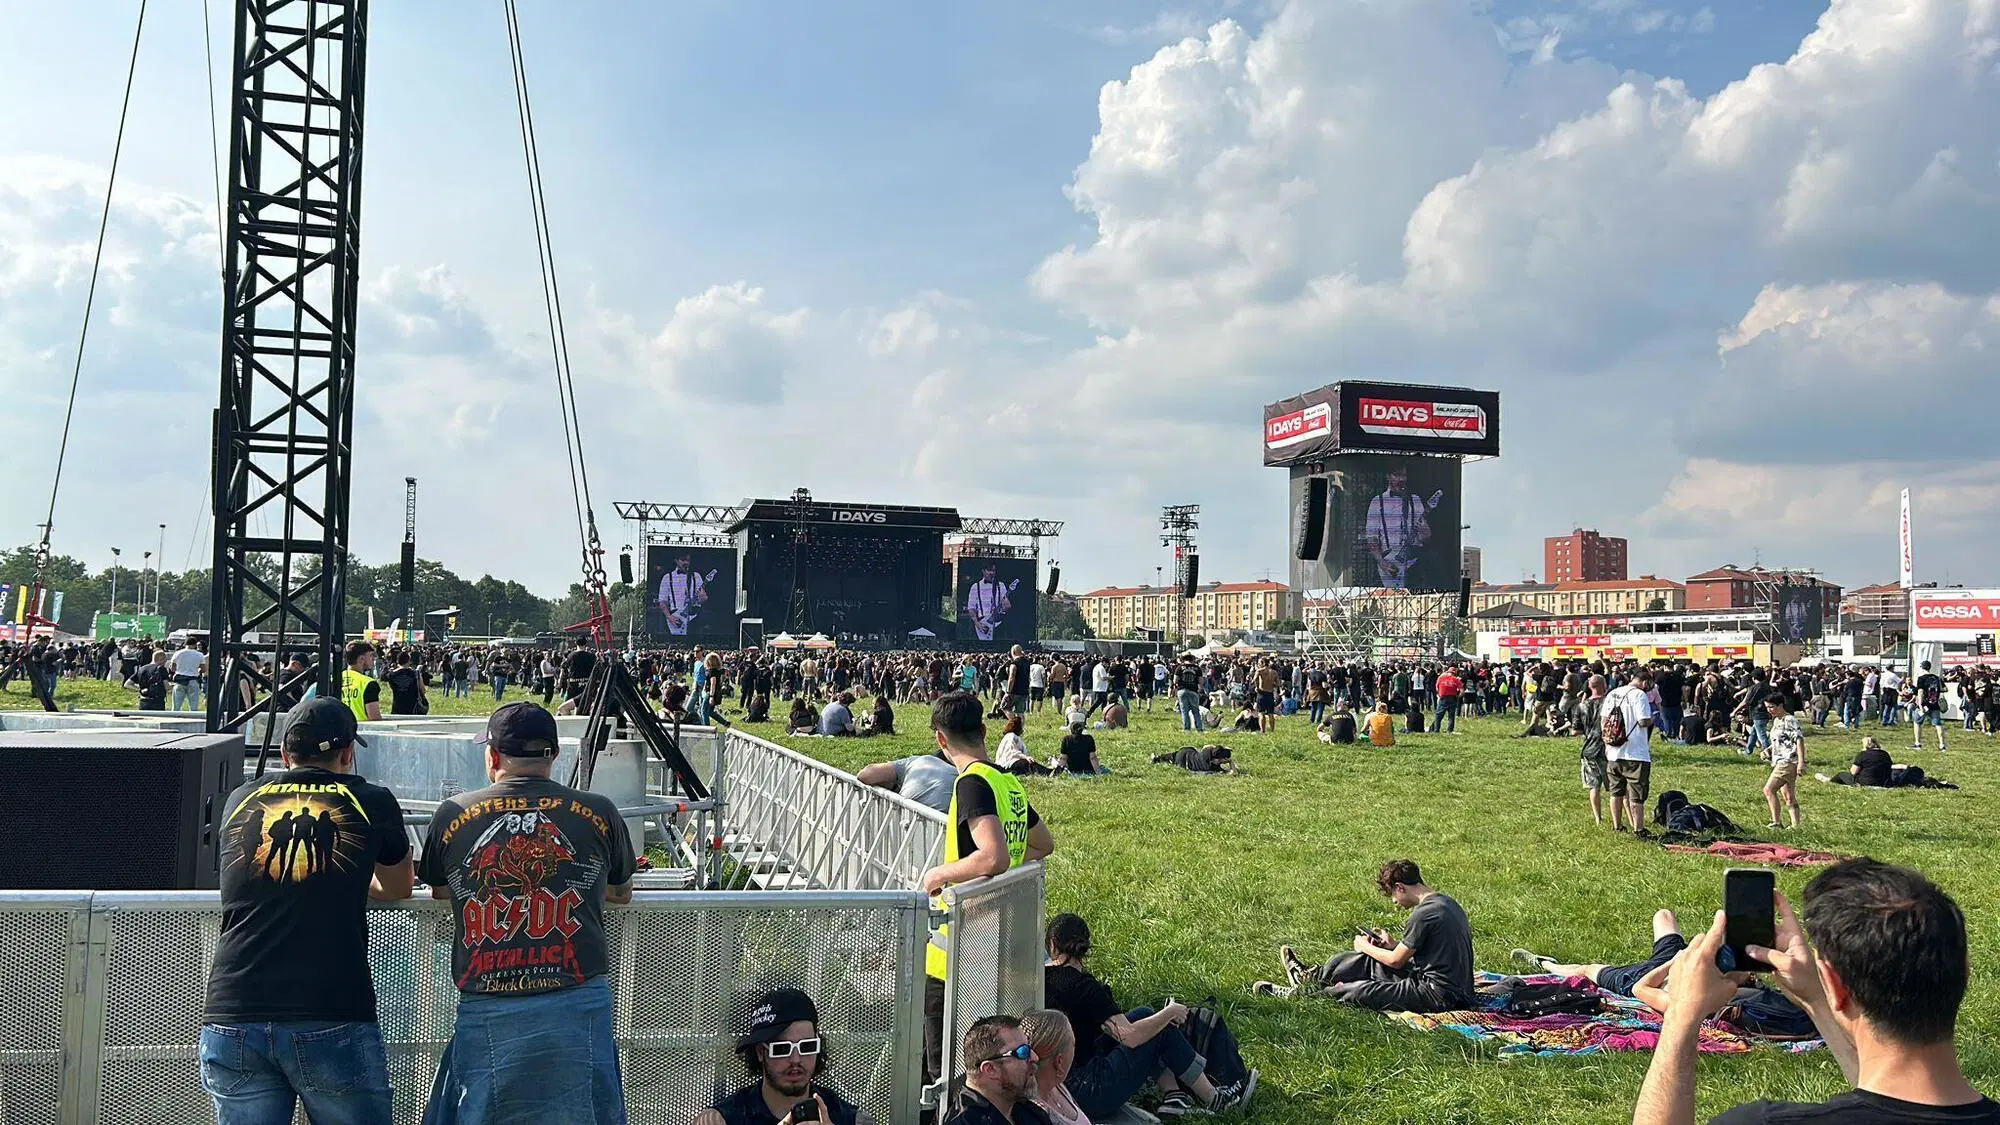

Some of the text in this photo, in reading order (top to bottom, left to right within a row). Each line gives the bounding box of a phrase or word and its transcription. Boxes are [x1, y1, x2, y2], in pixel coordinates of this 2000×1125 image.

[1363, 404, 1429, 423] I DAYS
[1272, 416, 1303, 437] DAYS
[832, 511, 887, 523] I DAYS
[1919, 605, 1982, 619] CASSA
[224, 780, 371, 826] METALLICA
[442, 797, 609, 845] MONSTERS OF ROCK
[457, 938, 585, 989] METALLICA
[519, 975, 561, 991] Crowes
